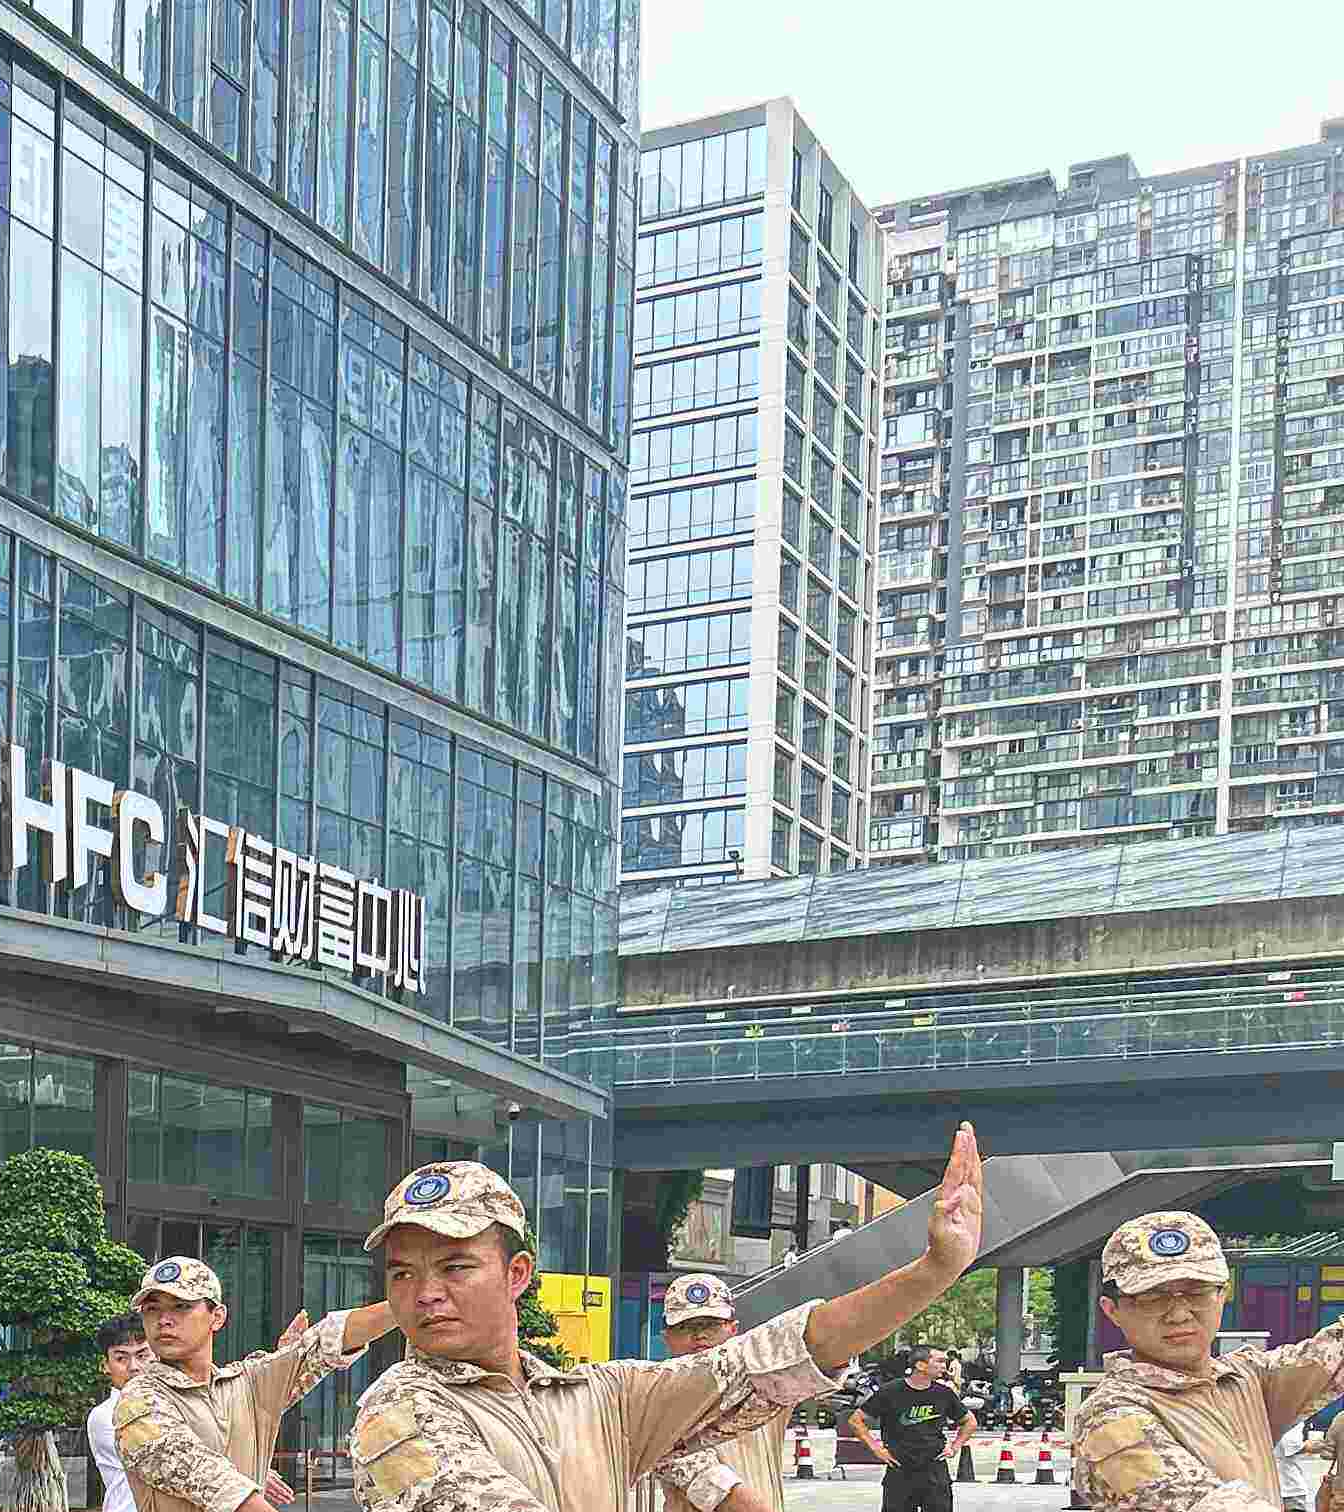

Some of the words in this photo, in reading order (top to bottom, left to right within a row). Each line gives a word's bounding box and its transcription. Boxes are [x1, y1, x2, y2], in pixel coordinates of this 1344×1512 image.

[10, 743, 168, 915] HFC
[185, 808, 426, 995] 汇信财富中心
